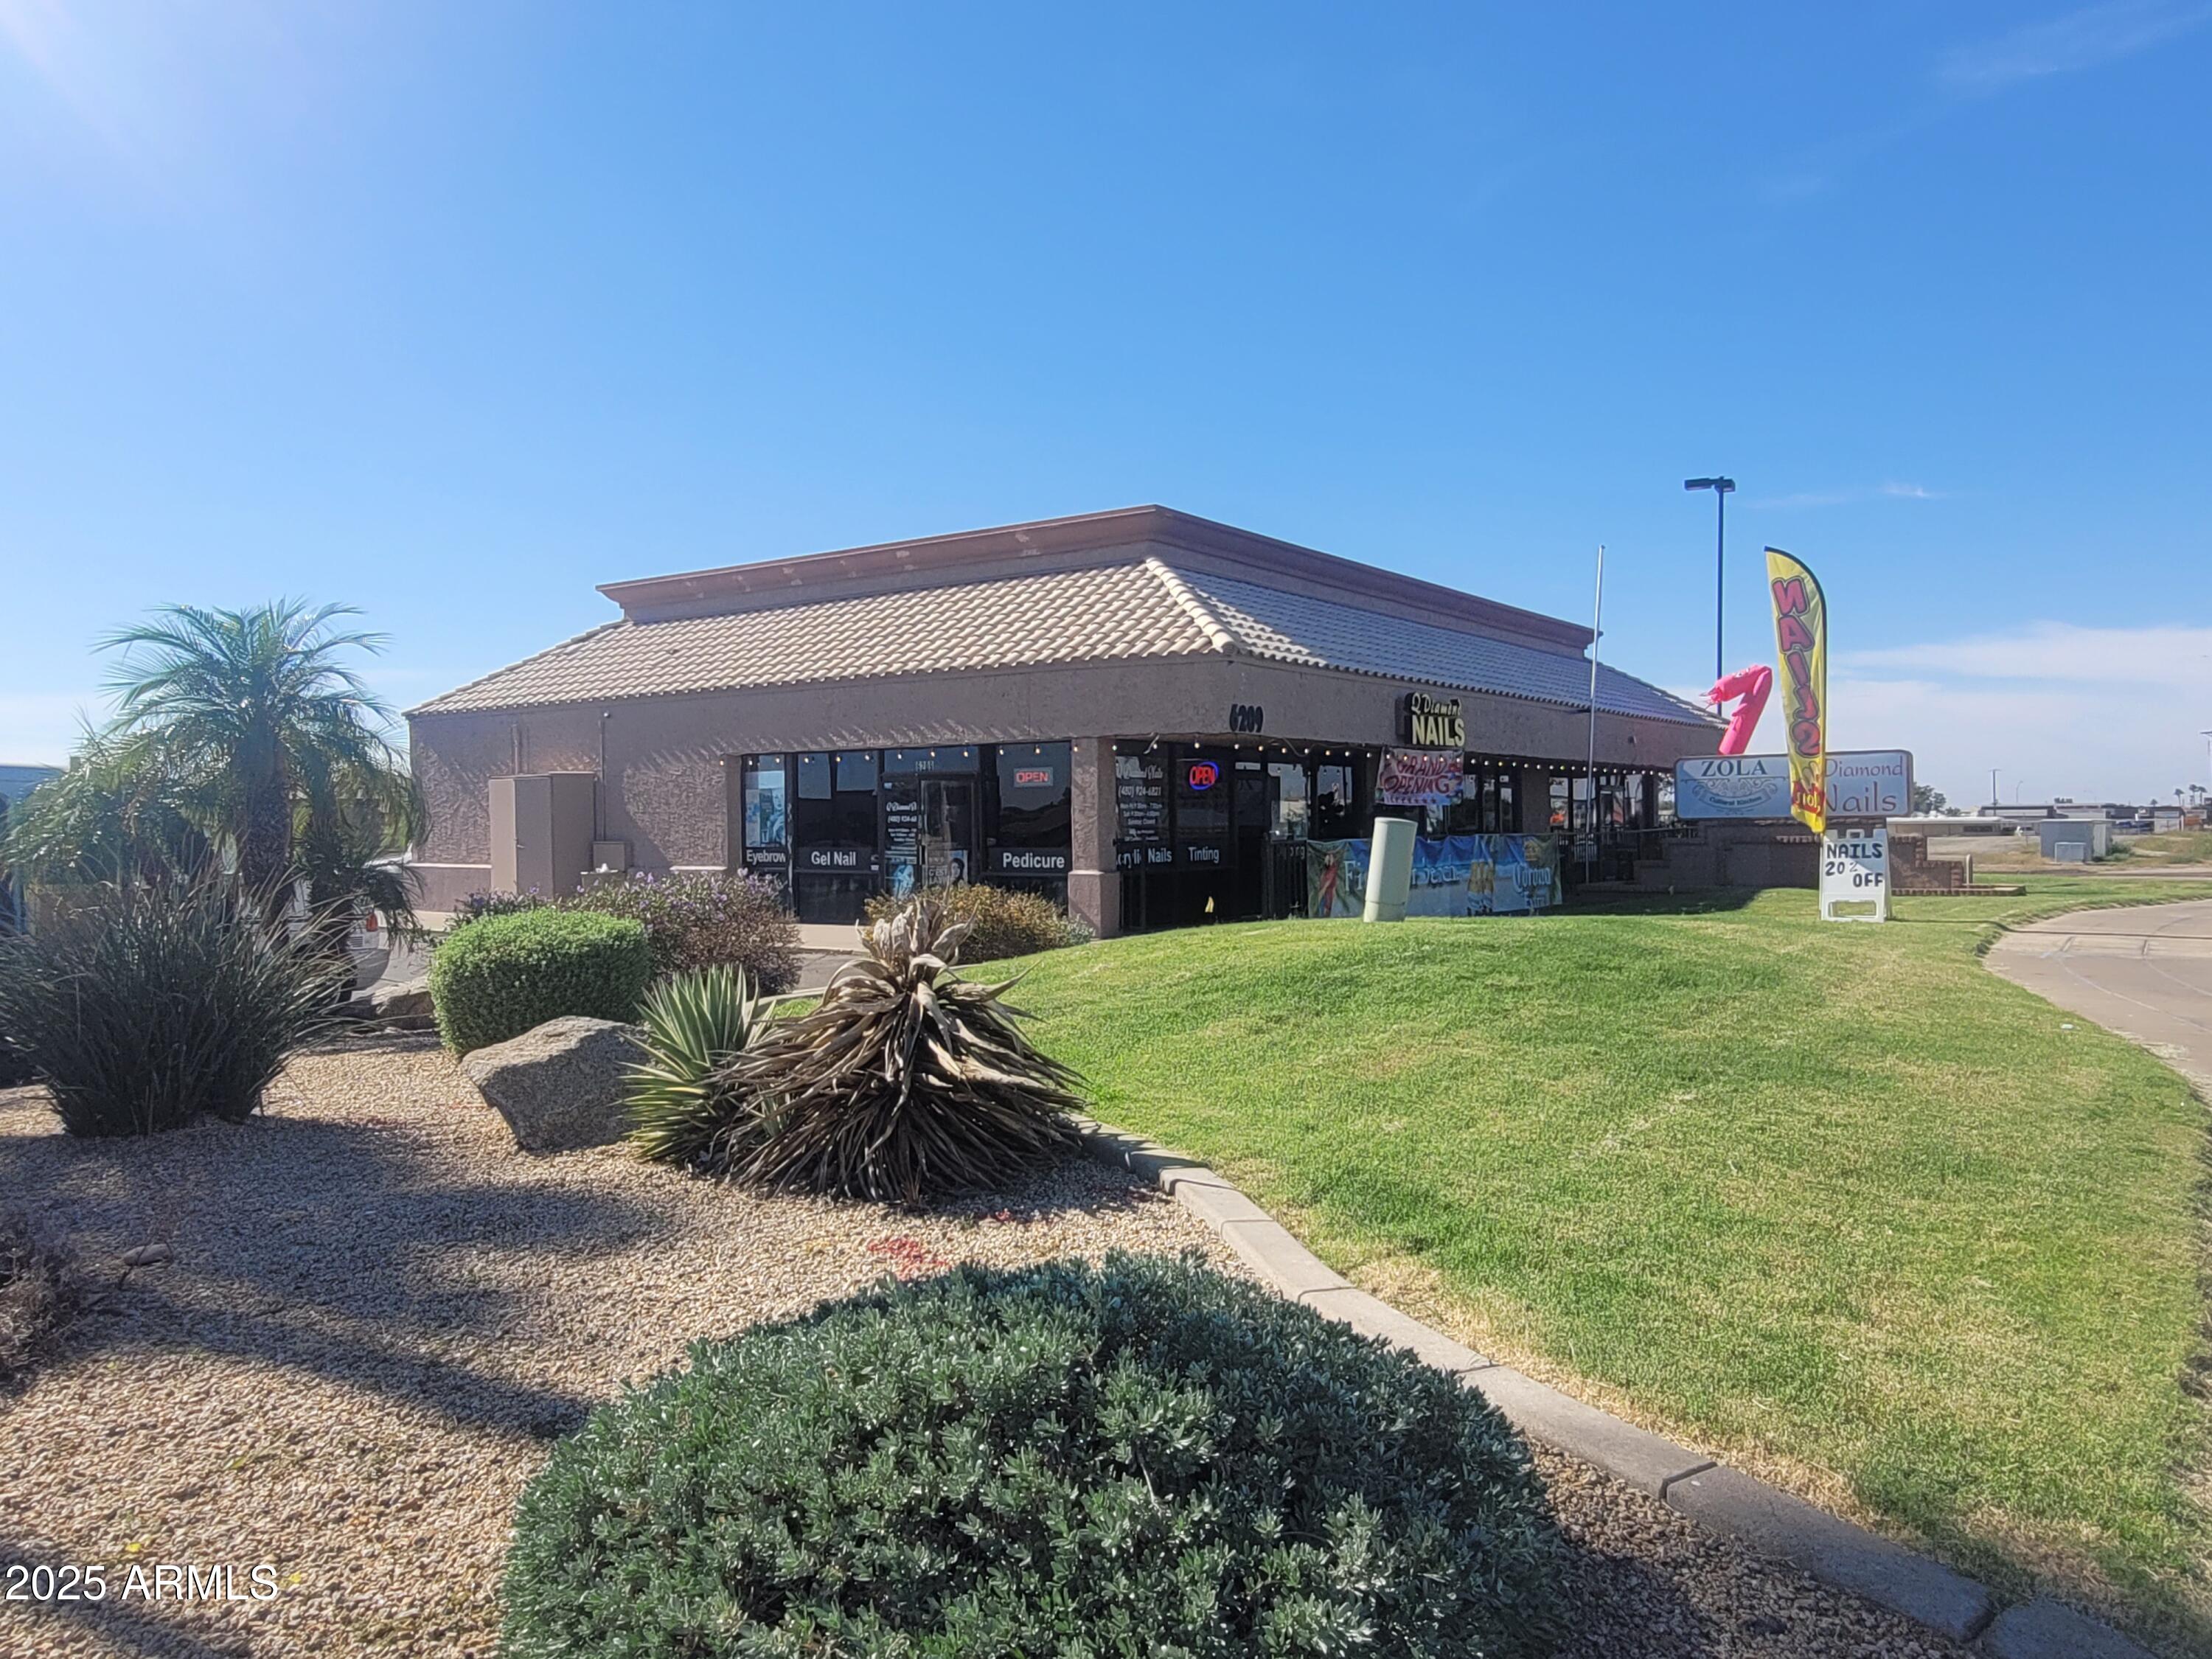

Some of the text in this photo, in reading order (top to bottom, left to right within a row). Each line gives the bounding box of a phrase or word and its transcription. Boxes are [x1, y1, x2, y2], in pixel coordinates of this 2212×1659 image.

[1411, 692, 1421, 715] Q
[1412, 714, 1465, 746] NAILS
[1397, 755, 1448, 776] GRAND
[1701, 759, 1768, 777] ZOLA
[1825, 755, 1903, 778] Diamond
[1016, 771, 1048, 784] OPEN
[1190, 765, 1216, 785] OPEN
[1384, 775, 1450, 794] OPENING
[1826, 781, 1897, 812] Nails
[746, 849, 786, 865] Eyebrow
[811, 851, 856, 866] Gel Nail
[1148, 847, 1172, 863] Nails
[1188, 846, 1220, 863] Tinting
[1826, 843, 1882, 859] NAILS
[1002, 852, 1065, 869] Pedicure
[1852, 872, 1884, 888] OFF
